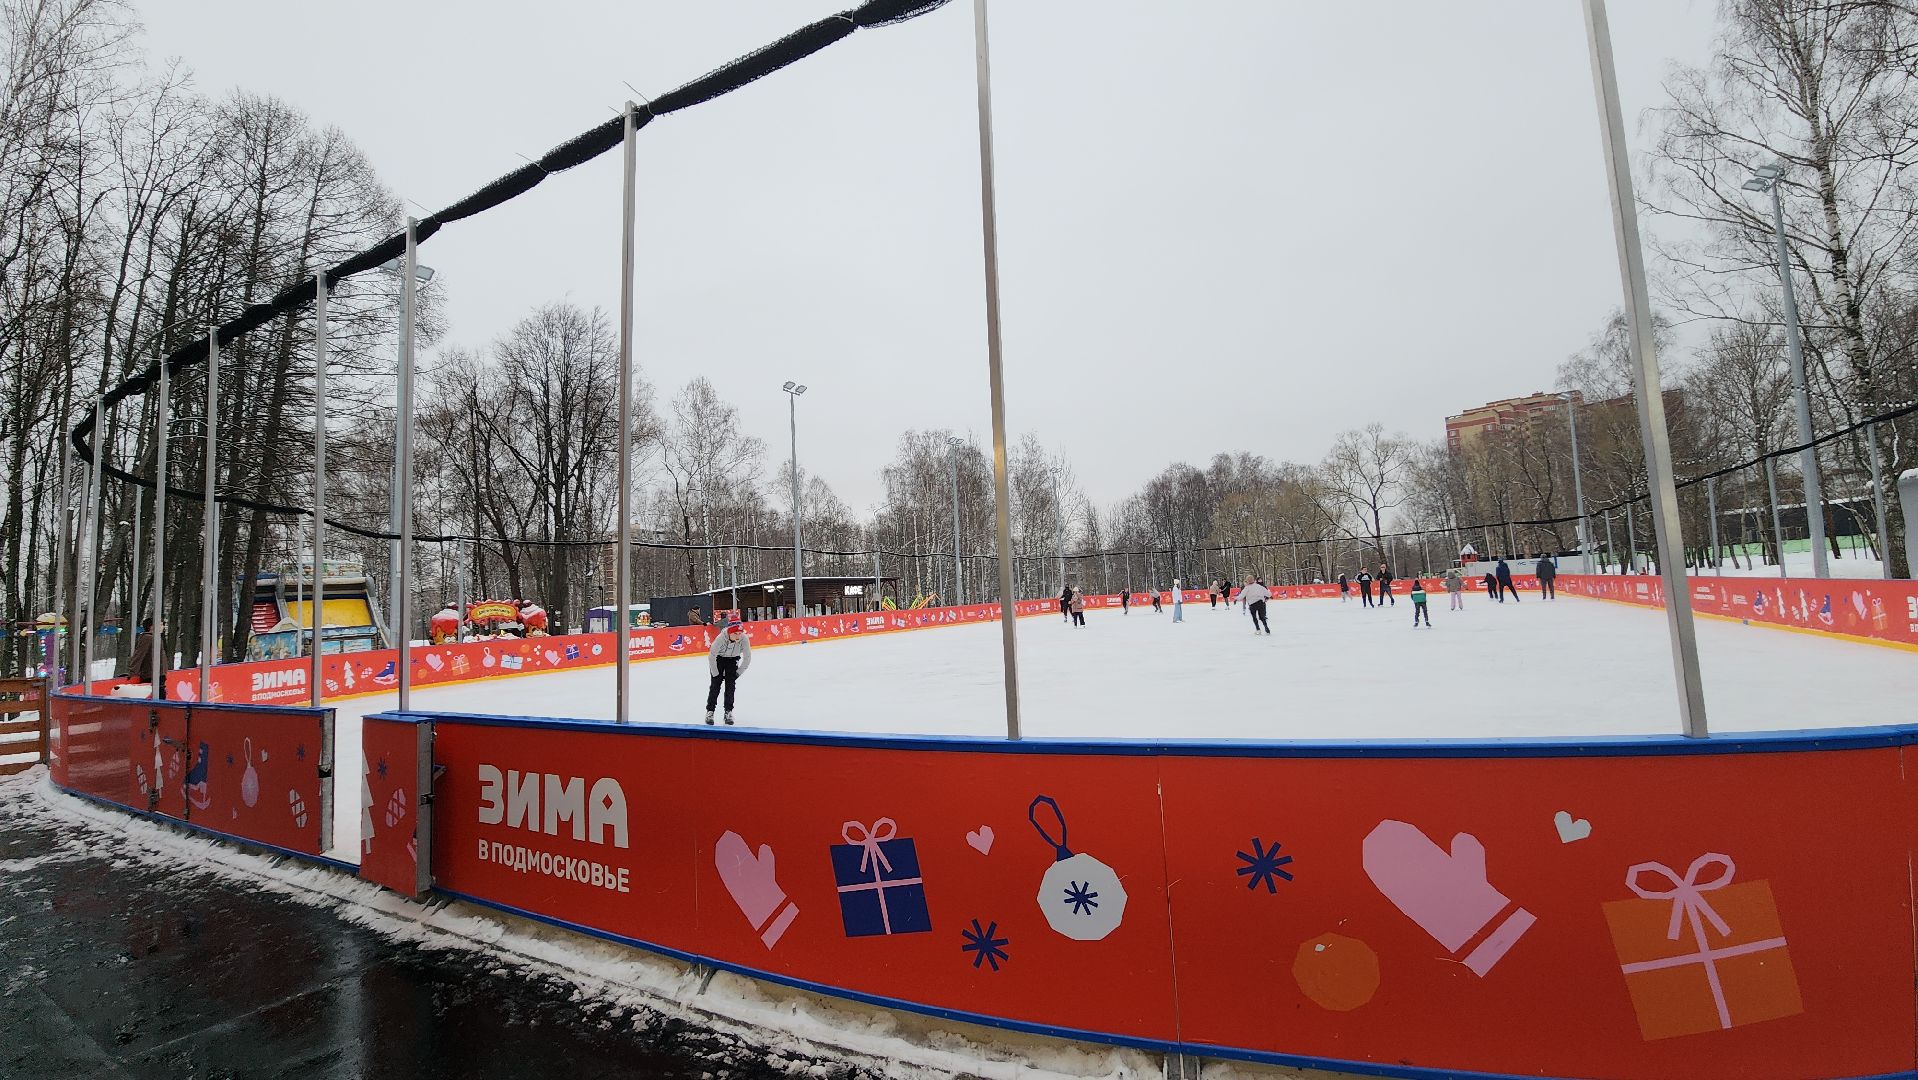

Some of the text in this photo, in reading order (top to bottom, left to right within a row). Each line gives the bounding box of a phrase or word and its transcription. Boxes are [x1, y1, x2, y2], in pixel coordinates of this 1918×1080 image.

[844, 585, 864, 596] КАФЕ
[866, 616, 885, 626] ЗИМА
[628, 635, 655, 649] ИМА
[252, 668, 306, 691] ЗИМА
[478, 764, 630, 849] ЗИМА
[478, 838, 630, 893] В ПОДМОСКОВЬЕ
